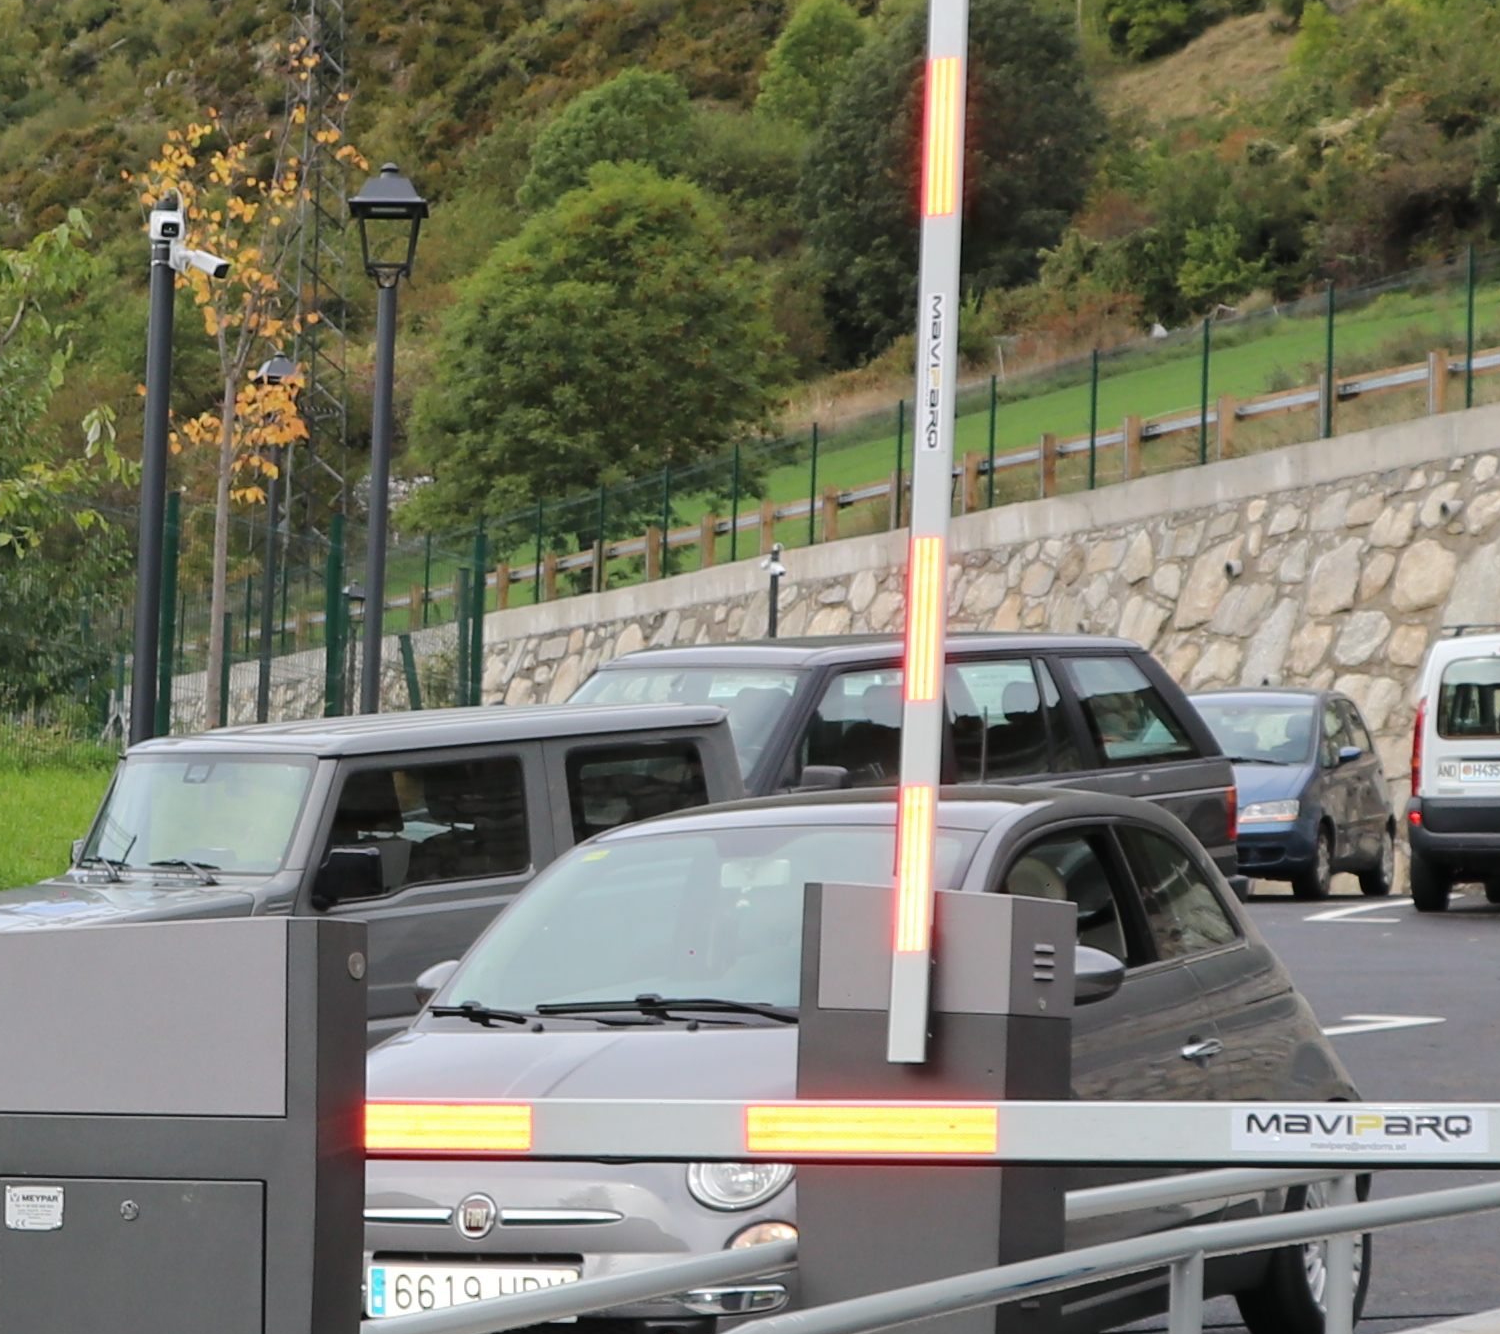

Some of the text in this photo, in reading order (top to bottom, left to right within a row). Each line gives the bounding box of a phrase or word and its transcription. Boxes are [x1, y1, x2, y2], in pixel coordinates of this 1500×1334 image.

[1437, 764, 1457, 777] AND
[22, 1194, 59, 1203] MEYPAR
[466, 1208, 488, 1228] FIAT
[395, 1274, 482, 1311] 6619
